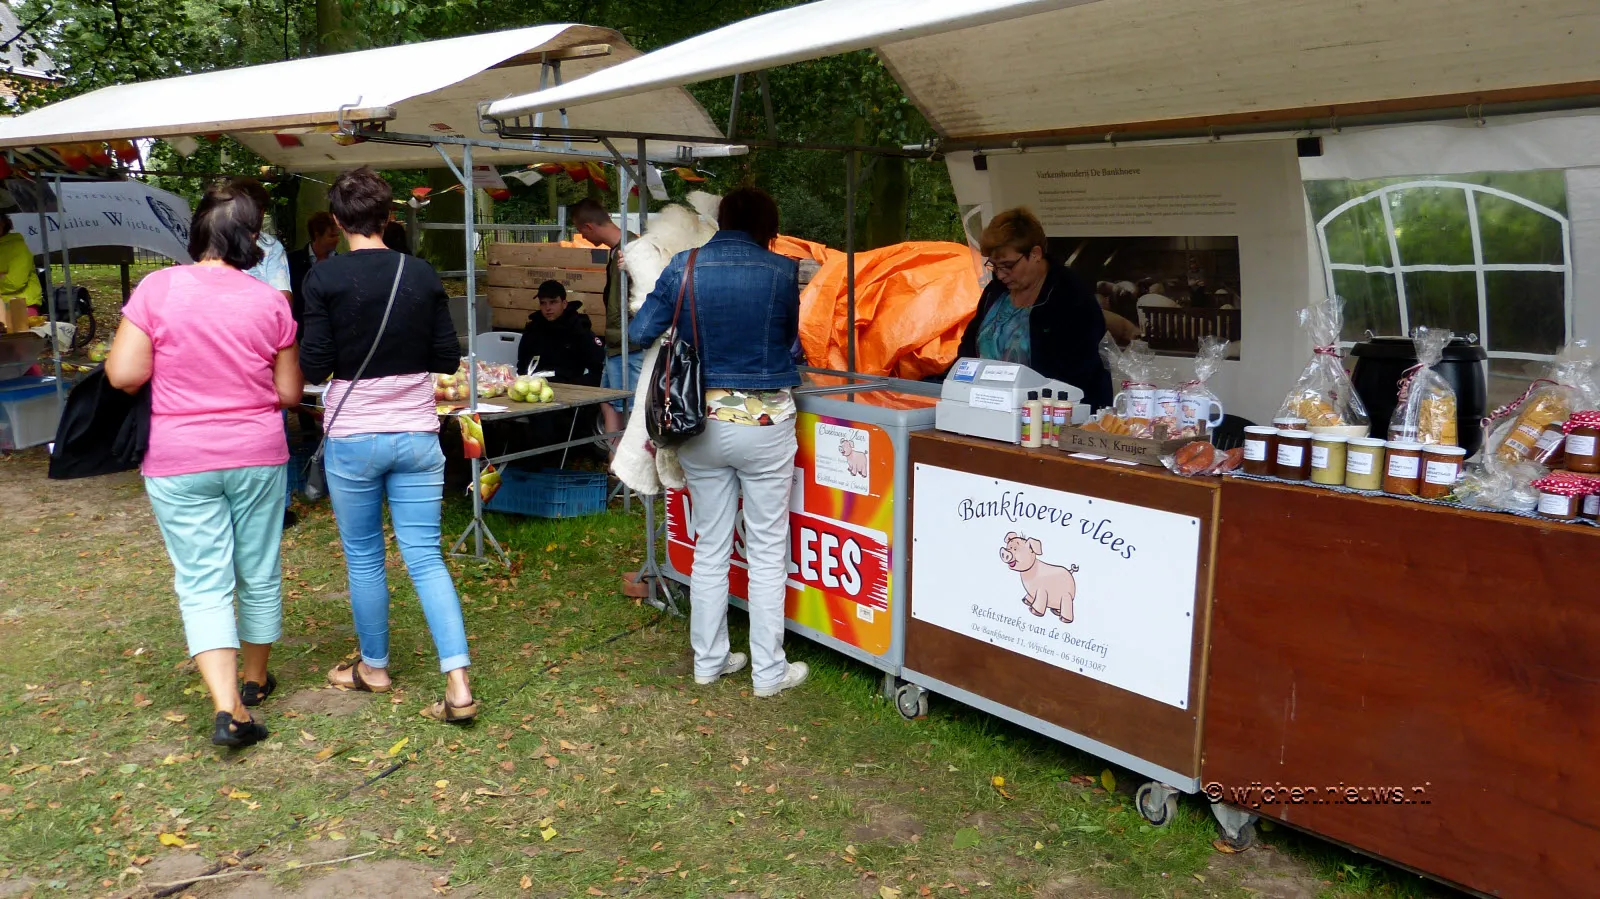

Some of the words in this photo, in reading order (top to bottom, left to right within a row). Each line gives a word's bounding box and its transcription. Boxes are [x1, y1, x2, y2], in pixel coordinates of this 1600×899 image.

[1036, 169, 1090, 179] Varkenshouderij
[1090, 168, 1101, 177] De
[1101, 167, 1141, 177] Bankhoeve
[28, 225, 39, 236] &
[45, 215, 99, 232] Milieu
[102, 211, 161, 234] Wijchen
[1072, 435, 1085, 446] Fa.
[1087, 436, 1097, 447] S.
[1100, 438, 1109, 449] N.
[1113, 439, 1147, 455] Kruijer
[957, 491, 1073, 527] Bankhoeve
[1079, 518, 1136, 560] vlees
[785, 523, 863, 597] LEES
[971, 603, 1026, 632] Rechtstreeks
[1027, 623, 1046, 636] van
[1048, 627, 1060, 640] de
[1061, 631, 1109, 659] Boerderij
[971, 622, 980, 632] De
[981, 625, 1015, 643] Bankhoeve
[1016, 637, 1026, 648] 11,
[1027, 641, 1055, 656] Wijchen
[1060, 651, 1070, 661] 06
[1071, 655, 1107, 673] 36013087
